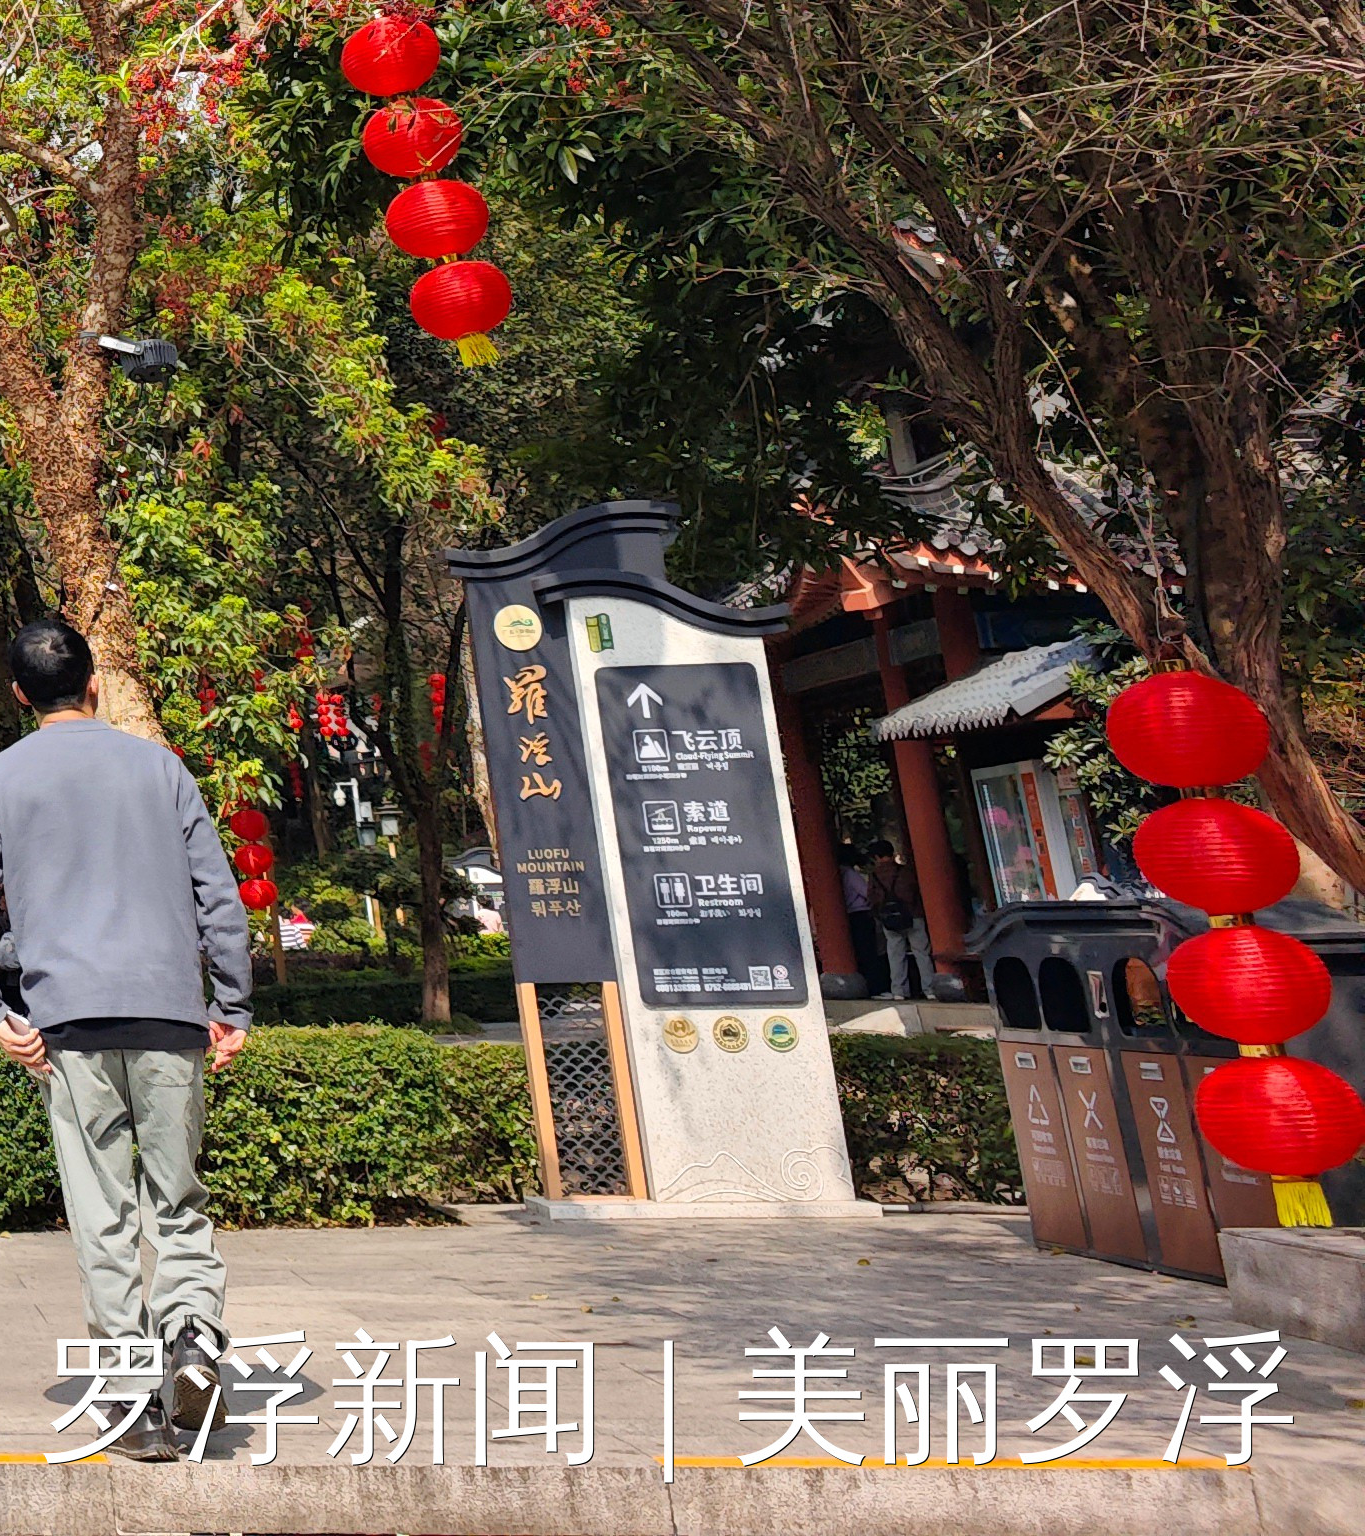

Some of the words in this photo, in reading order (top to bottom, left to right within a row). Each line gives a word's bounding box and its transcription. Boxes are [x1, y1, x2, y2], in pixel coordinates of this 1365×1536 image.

[671, 728, 742, 751] 飞云顶
[675, 751, 724, 762] Cloud-Flying
[724, 750, 755, 760] Summit
[683, 800, 730, 822] 索道
[527, 848, 570, 860] LUOFU
[516, 860, 585, 874] MOUNTAIN
[527, 877, 580, 895] 羅浮山
[694, 873, 763, 895] 卫生间
[697, 898, 744, 907] Restroom
